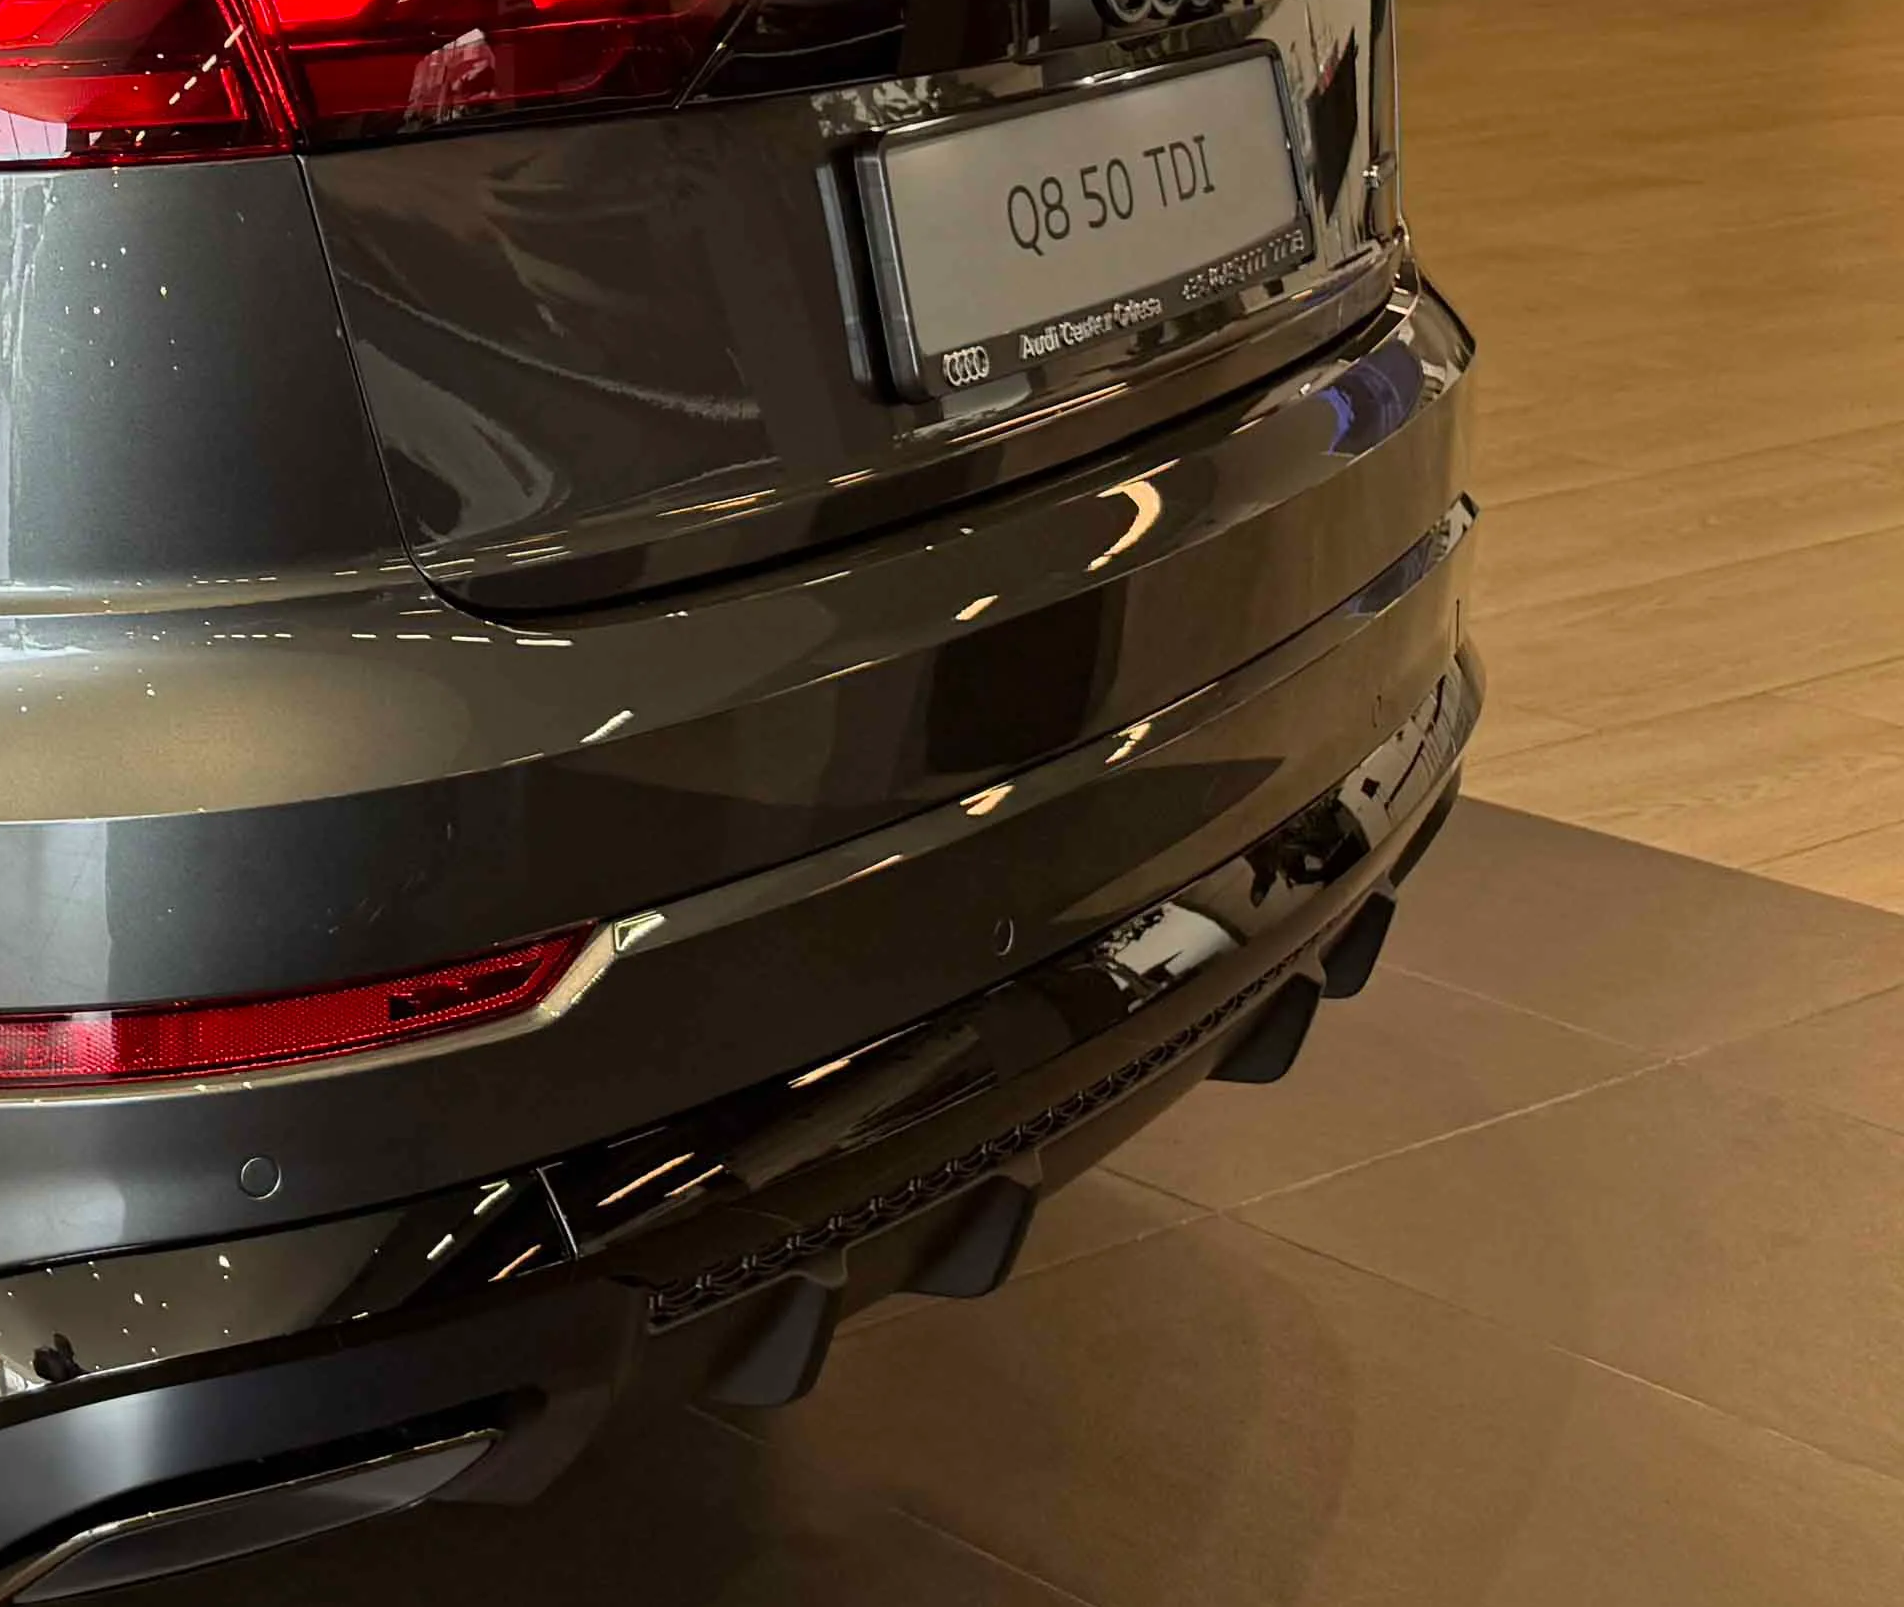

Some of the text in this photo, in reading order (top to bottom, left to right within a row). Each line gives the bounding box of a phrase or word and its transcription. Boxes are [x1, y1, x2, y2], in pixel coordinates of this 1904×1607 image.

[1007, 134, 1215, 256] Q8 50 TDI
[1020, 327, 1060, 360] Audi
